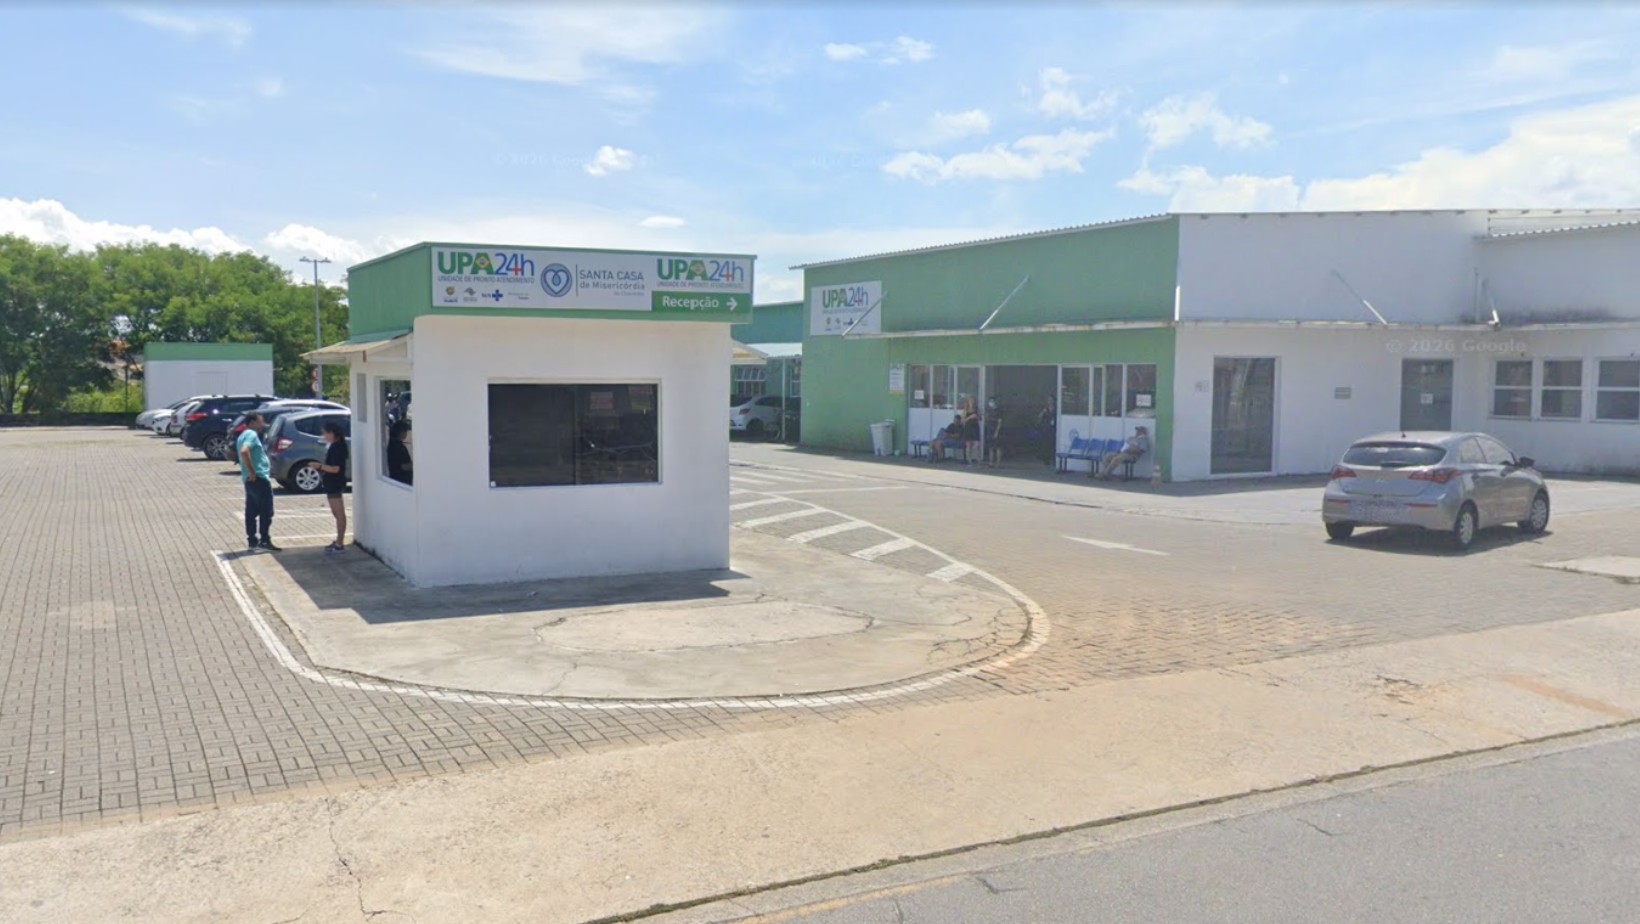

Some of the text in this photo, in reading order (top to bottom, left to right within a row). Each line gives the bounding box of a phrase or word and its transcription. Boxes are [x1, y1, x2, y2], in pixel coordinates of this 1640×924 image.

[579, 269, 644, 281] SANTA CASA
[579, 281, 645, 290] de Misericórdia
[662, 296, 720, 310] Recepção
